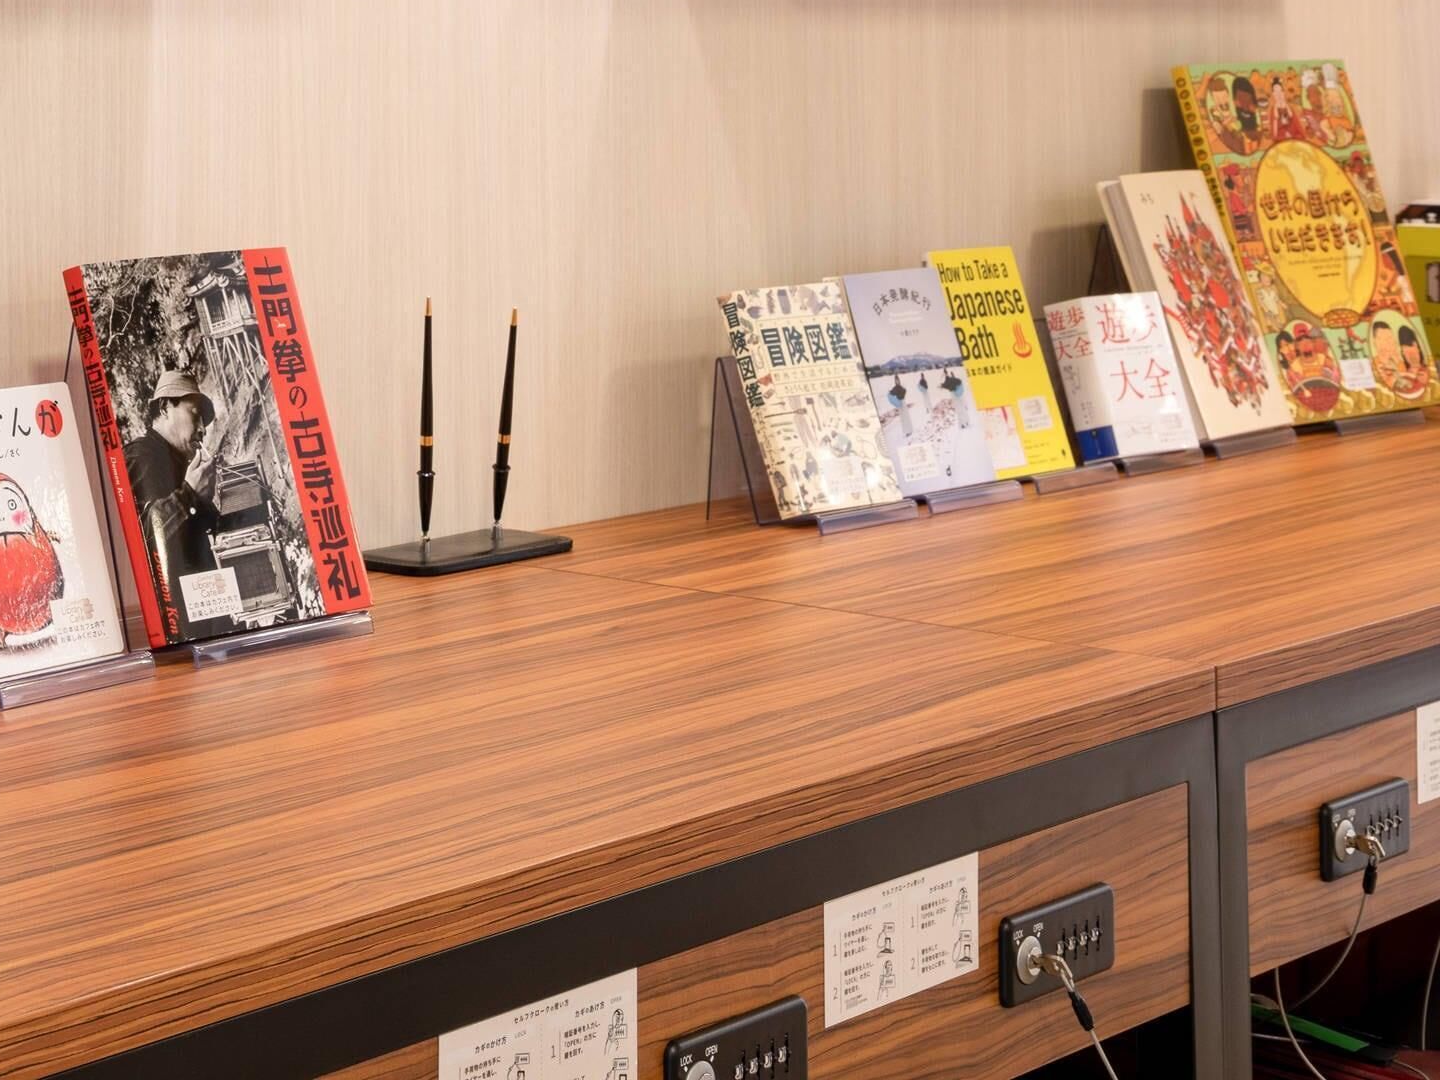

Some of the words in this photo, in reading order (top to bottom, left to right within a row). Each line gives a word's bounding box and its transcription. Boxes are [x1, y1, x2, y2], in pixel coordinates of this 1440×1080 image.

[937, 263, 960, 283] How
[961, 262, 975, 281] to
[973, 259, 1000, 280] Take
[1001, 263, 1009, 278] a
[945, 286, 1024, 326] Japanese
[761, 322, 853, 367] 冒険図鑑
[954, 324, 999, 360] Bath
[1110, 358, 1176, 402] 大全
[253, 256, 360, 601] 土門拳の古寺巡礼
[166, 607, 179, 634] Ken
[551, 1045, 556, 1059] 1
[680, 1054, 693, 1067] LOCK
[705, 1044, 719, 1057] OPEN
